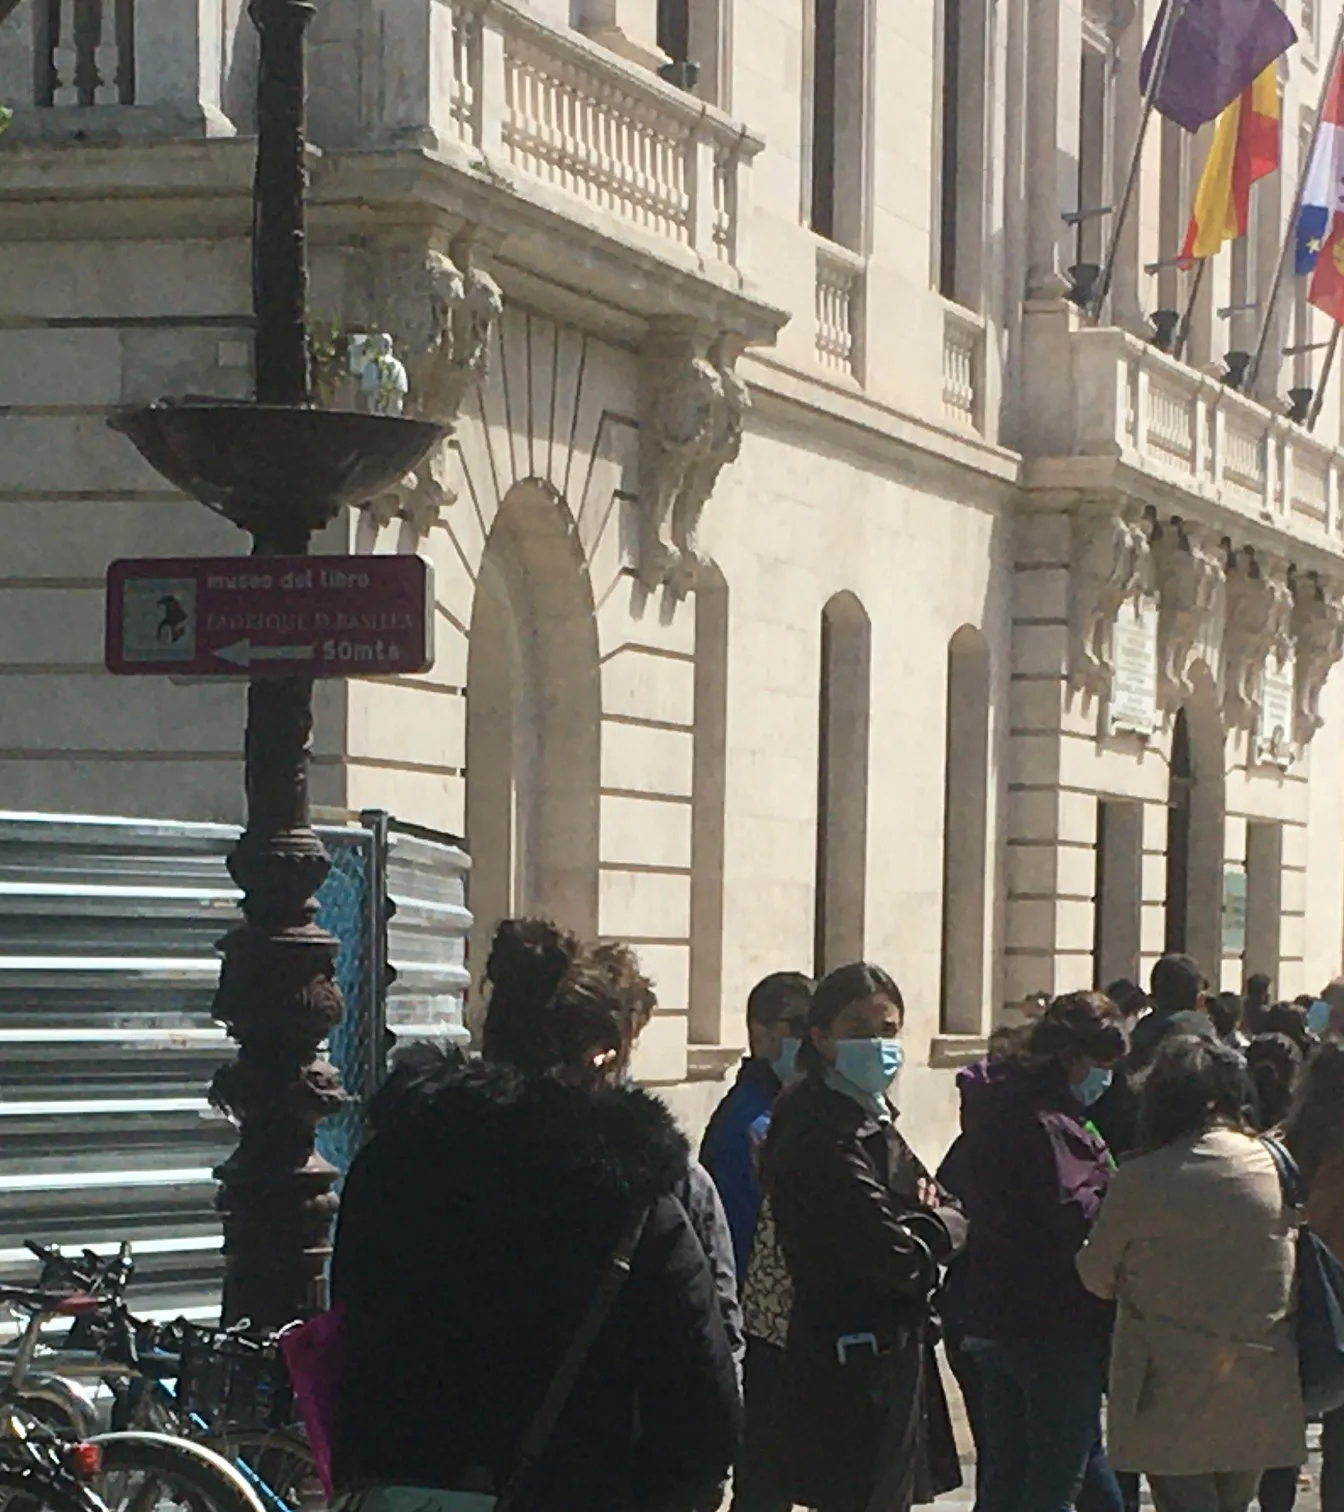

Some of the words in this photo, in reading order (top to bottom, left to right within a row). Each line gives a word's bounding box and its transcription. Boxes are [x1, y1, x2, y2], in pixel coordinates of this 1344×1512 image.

[207, 573, 274, 589] museo
[280, 568, 313, 589] del
[320, 568, 370, 589] libro
